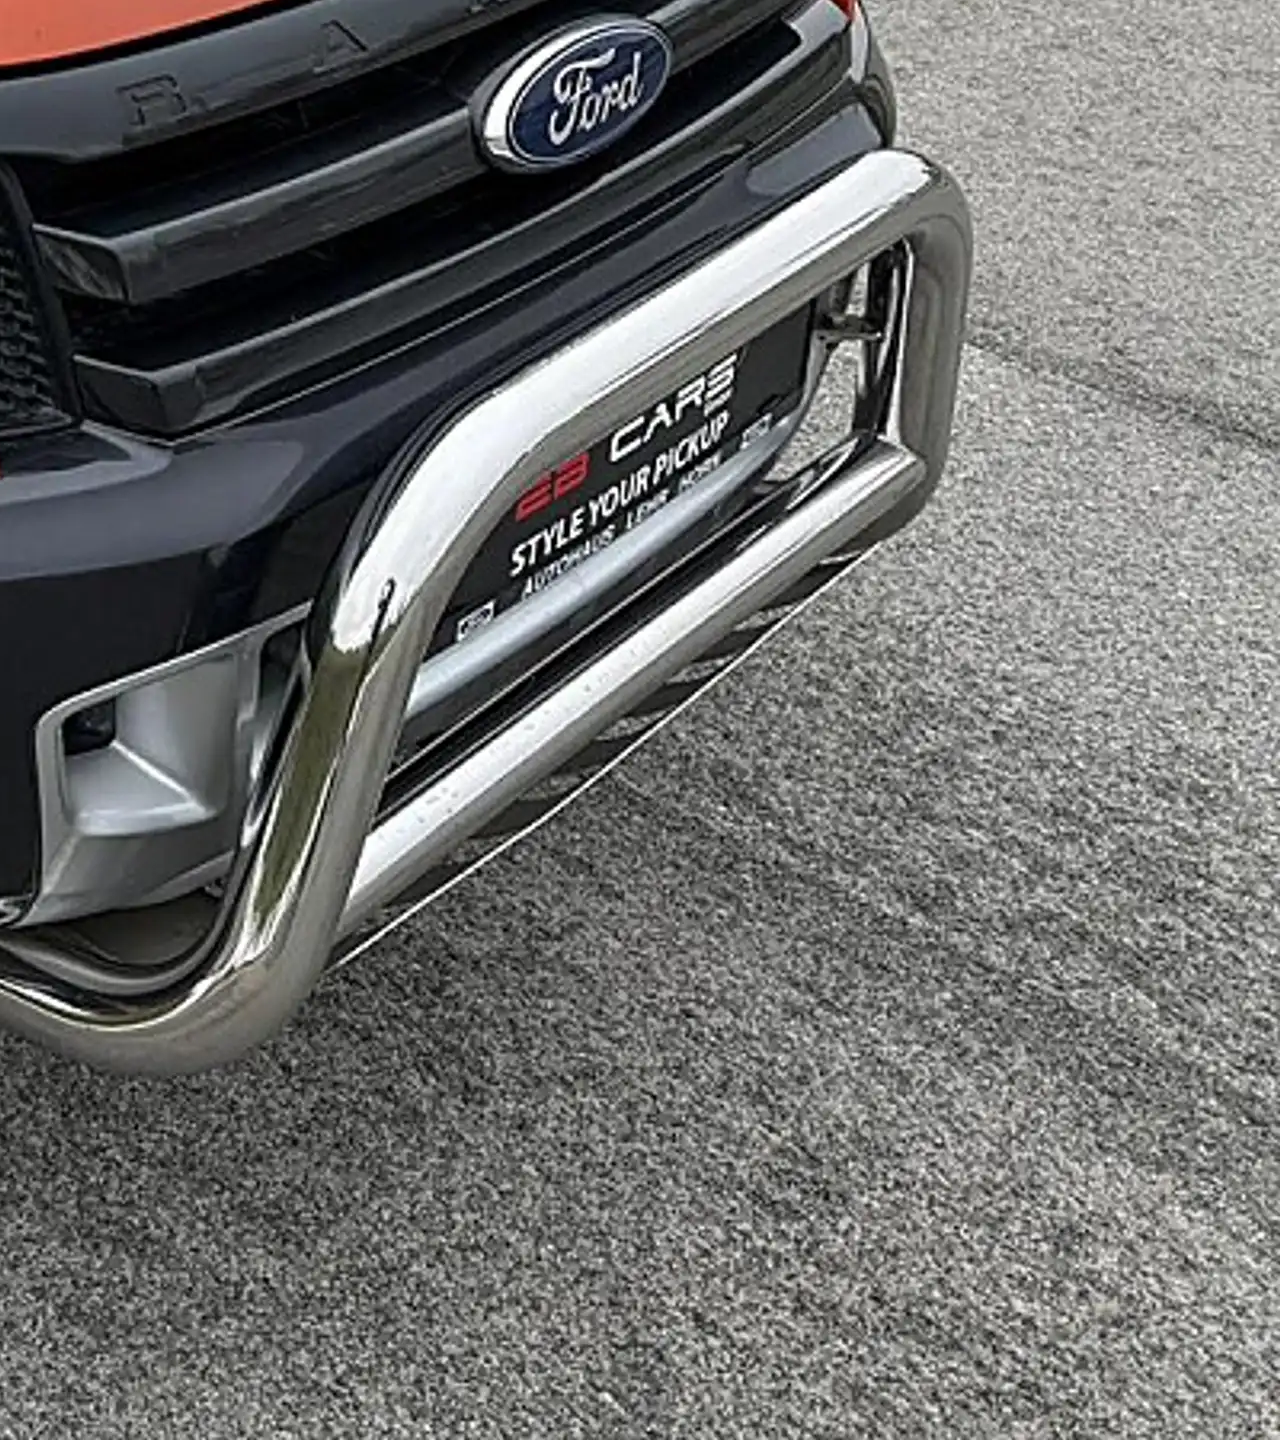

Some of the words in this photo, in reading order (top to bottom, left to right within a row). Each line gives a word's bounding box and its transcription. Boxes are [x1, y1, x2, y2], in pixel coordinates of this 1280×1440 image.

[547, 47, 643, 146] Ford
[609, 353, 738, 462] CARS
[509, 505, 586, 578] STYLE
[588, 464, 651, 527] YOUR
[652, 410, 730, 486] PICKUP
